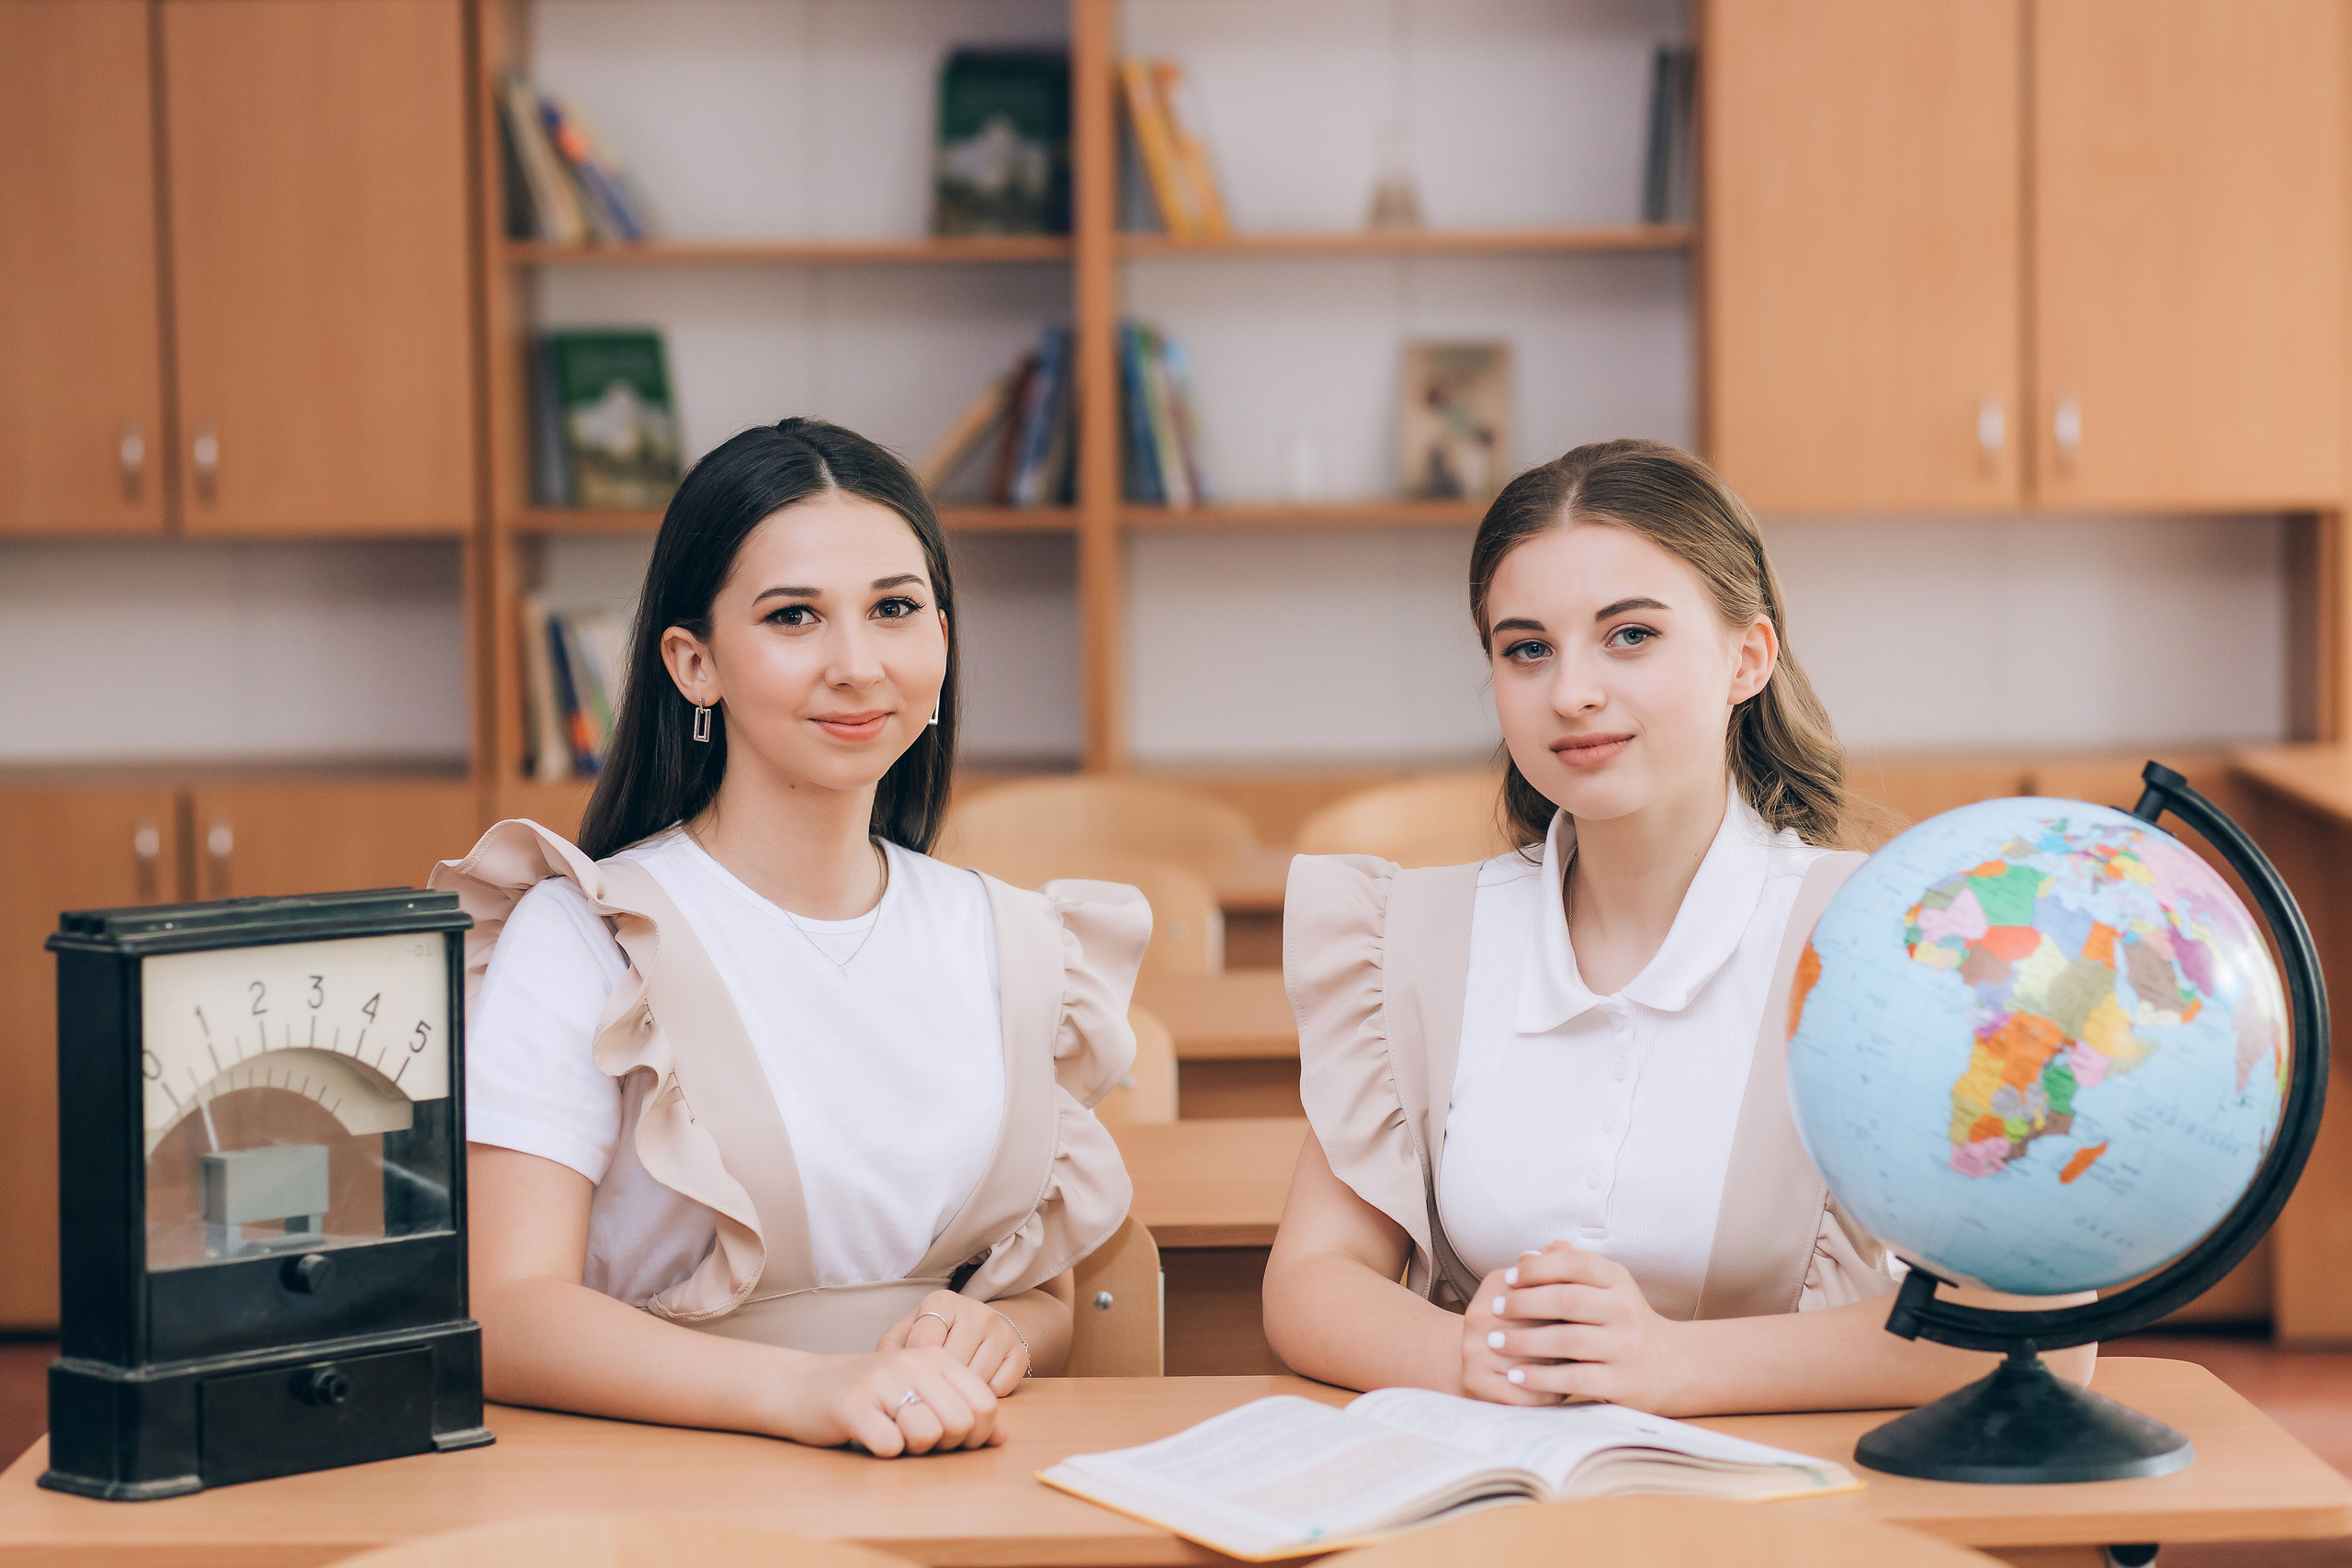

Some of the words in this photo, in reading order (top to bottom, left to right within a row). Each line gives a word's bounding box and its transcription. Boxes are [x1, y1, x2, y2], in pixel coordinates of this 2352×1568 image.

[141, 1049, 164, 1082] 0
[195, 1005, 211, 1038] 1
[248, 980, 269, 1017] 2
[307, 975, 325, 1010] 3
[362, 992, 381, 1025] 4
[409, 1020, 433, 1055] 5
